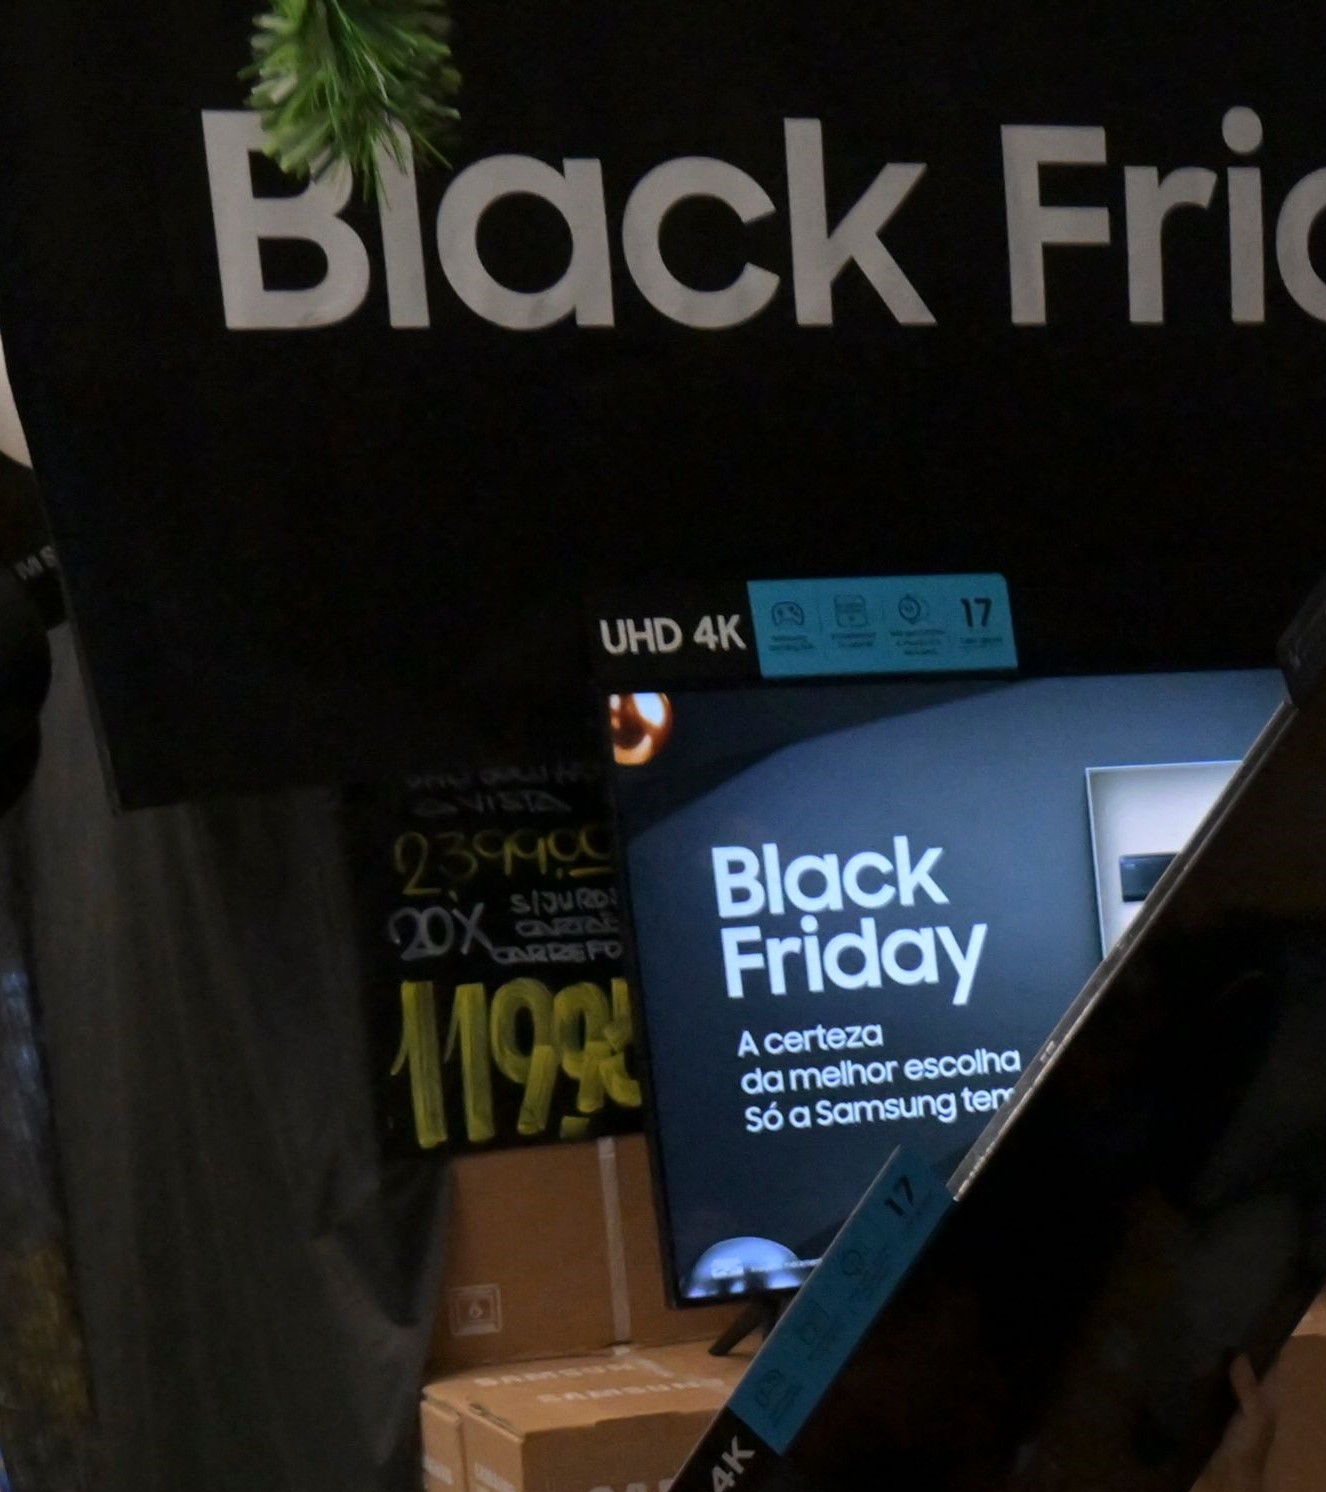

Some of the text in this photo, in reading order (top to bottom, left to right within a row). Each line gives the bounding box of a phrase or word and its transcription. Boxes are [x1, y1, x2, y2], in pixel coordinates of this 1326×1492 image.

[201, 110, 937, 331] Black
[600, 617, 684, 655] UHD
[693, 614, 747, 652] 4K
[960, 597, 992, 628] 17
[711, 836, 949, 919] Black
[494, 939, 622, 964] CARREFO
[722, 917, 987, 1006] Friday
[737, 1023, 884, 1058] A certeza
[741, 1048, 1021, 1095] da melhor escolha
[745, 1101, 785, 1134] Só
[789, 1106, 812, 1129] a
[816, 1090, 958, 1127] Samsung
